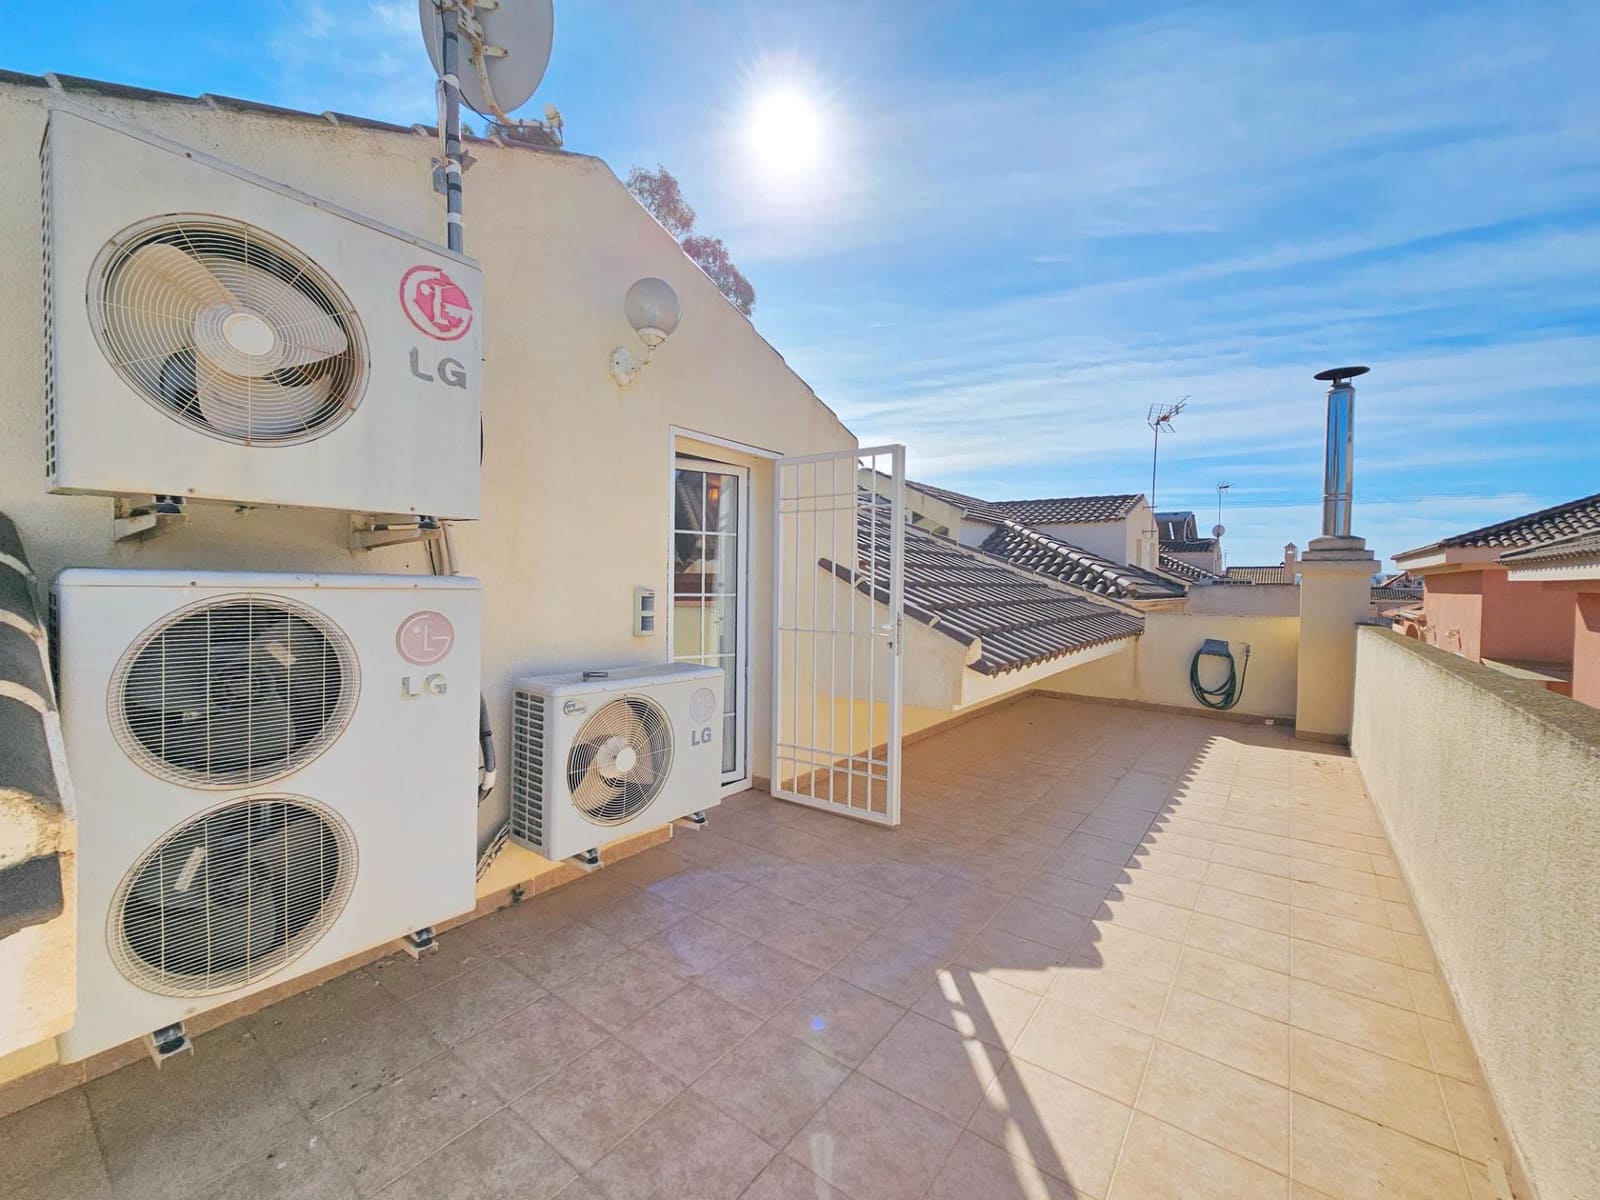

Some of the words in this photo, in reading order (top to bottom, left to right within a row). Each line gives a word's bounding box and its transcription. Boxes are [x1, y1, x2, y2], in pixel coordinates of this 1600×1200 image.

[409, 346, 467, 390] LG
[400, 672, 448, 700] LG
[691, 726, 712, 746] LG
